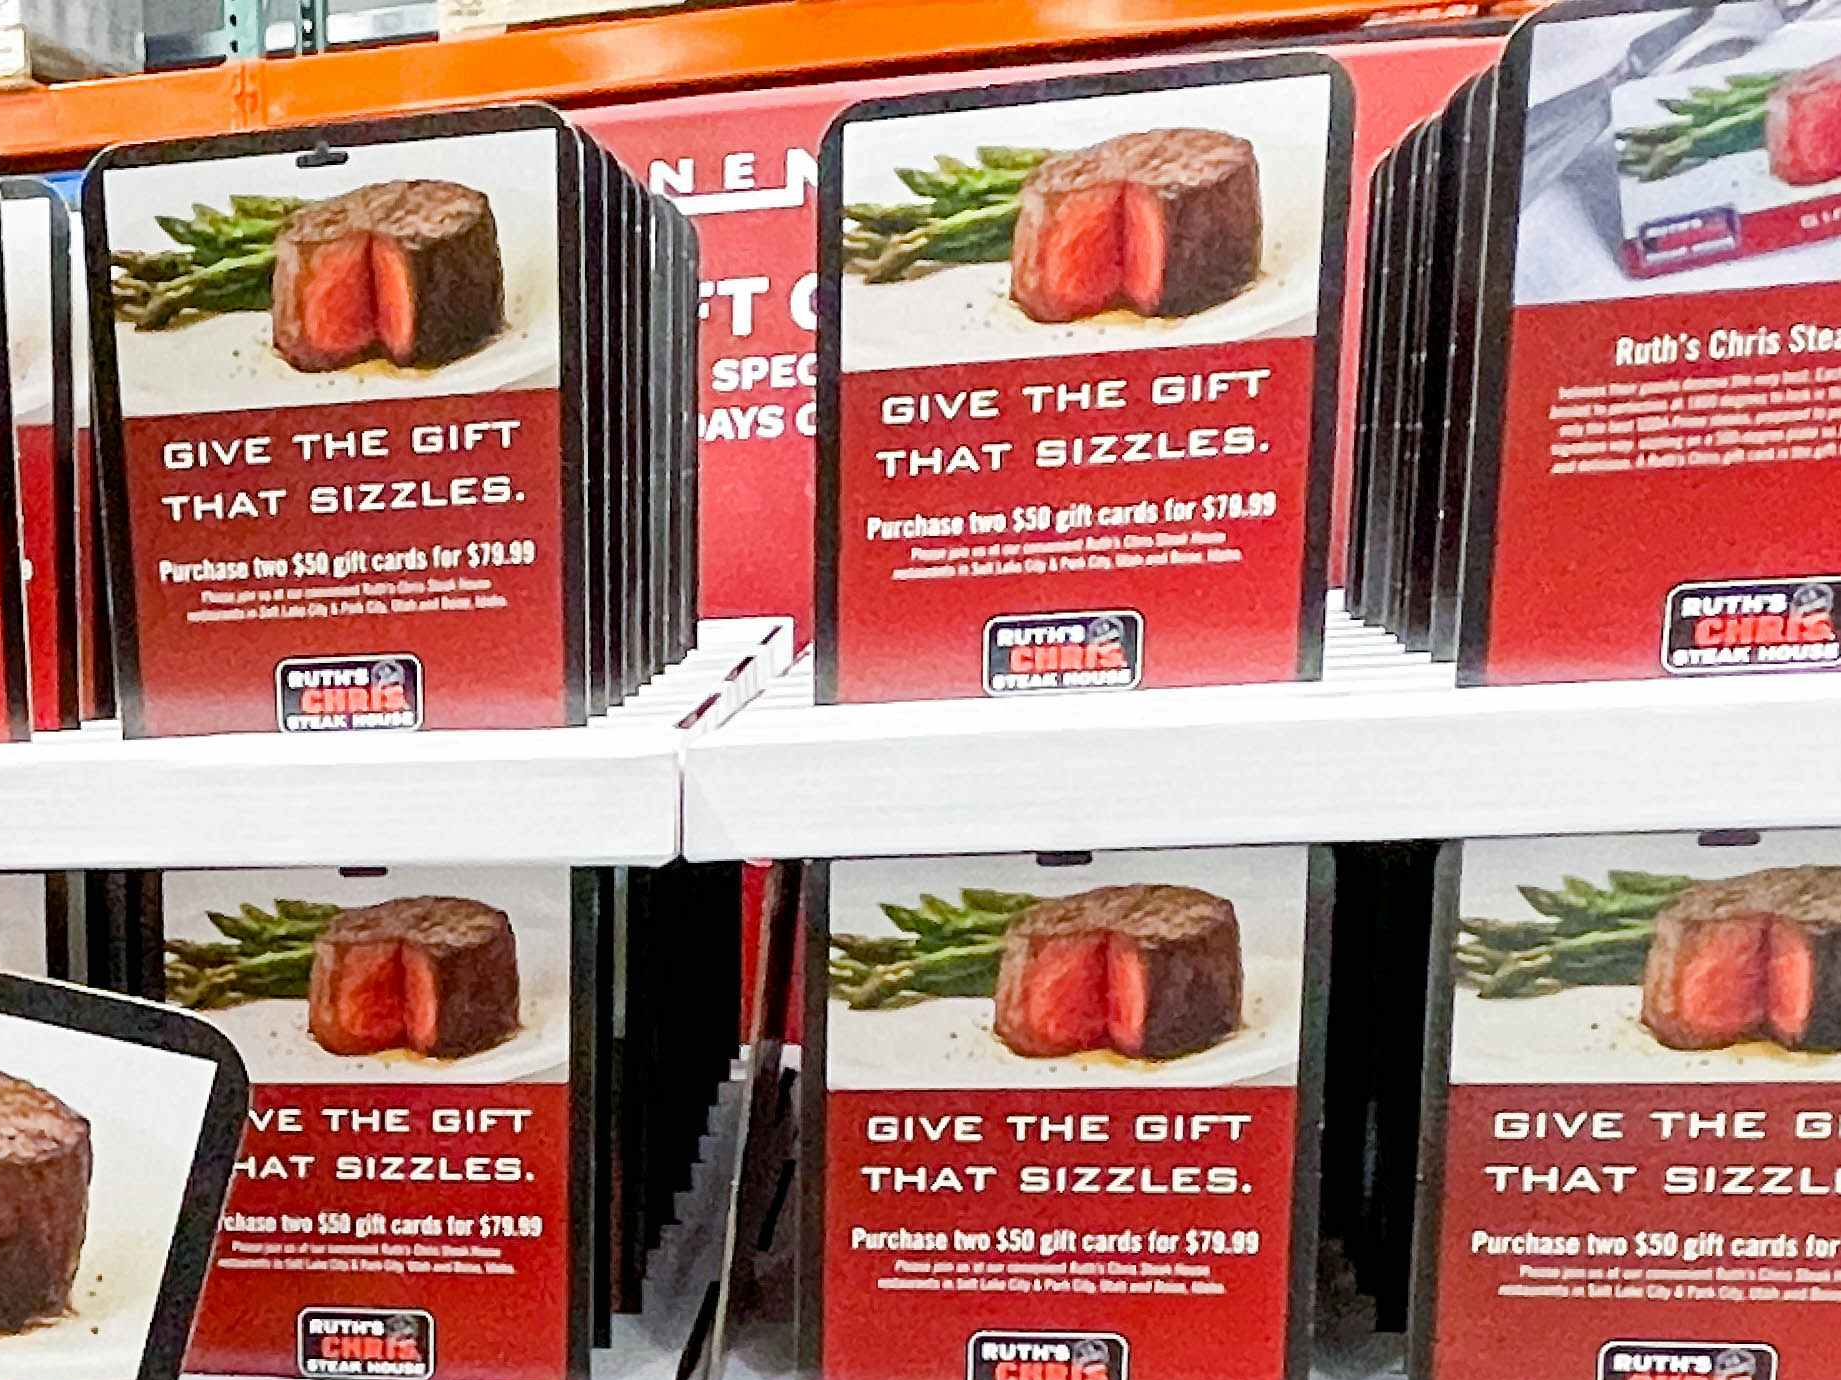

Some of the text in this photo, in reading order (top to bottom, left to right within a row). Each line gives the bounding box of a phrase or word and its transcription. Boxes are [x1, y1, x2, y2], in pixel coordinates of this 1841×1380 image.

[1615, 322, 1841, 366] Ruth's Chris Stea
[881, 368, 1271, 425] GIVE THE GIFT
[162, 420, 521, 469] GIVE THE GIFT
[875, 425, 1270, 479] THAT SIZZLES.
[161, 474, 525, 521] THAT SIZZLES.
[321, 1108, 532, 1134] THE GIFT
[866, 1114, 1252, 1143] GIVE THE GIFT
[1493, 1110, 1766, 1140] GIVE THE
[335, 1157, 534, 1182] SIZZLES.
[860, 1166, 1252, 1195] THAT SIZZLES.
[1484, 1165, 1638, 1193] THAT
[851, 1227, 947, 1252] Purchase
[954, 1230, 990, 1252] two
[996, 1227, 1034, 1253] $50
[1039, 1230, 1077, 1255] gift
[1081, 1230, 1143, 1254] cards
[1147, 1229, 1178, 1254] for
